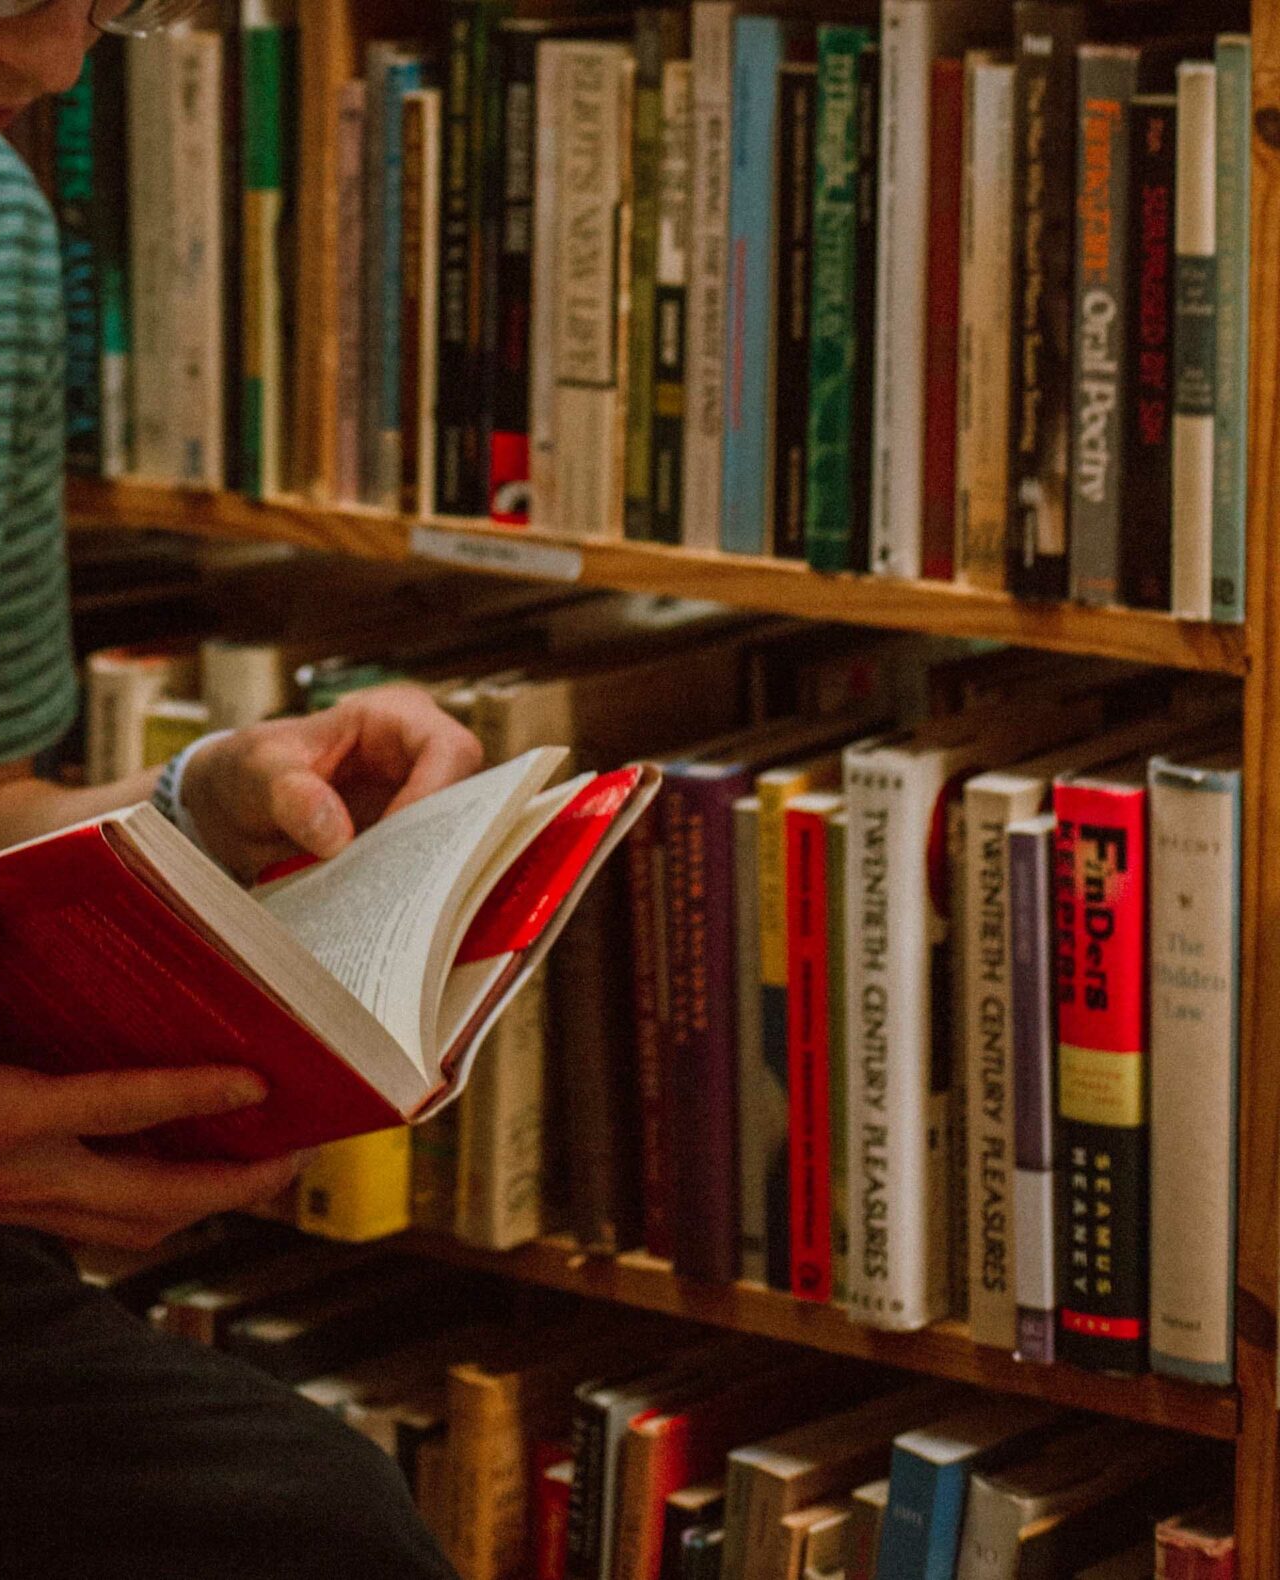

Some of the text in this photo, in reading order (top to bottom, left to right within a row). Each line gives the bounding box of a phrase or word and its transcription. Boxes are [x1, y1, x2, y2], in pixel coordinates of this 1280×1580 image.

[1081, 290, 1118, 373] Oral
[1078, 379, 1117, 502] Poetry
[861, 808, 889, 973] TWENTIETH
[861, 983, 889, 1112] CENTURY
[978, 822, 1007, 1295] TWENTIETH CENTURY PLEASURES
[862, 1125, 889, 1281] PLEASURES
[1072, 1147, 1089, 1294] HEANEY
[1093, 1152, 1111, 1295] SEAMUS
